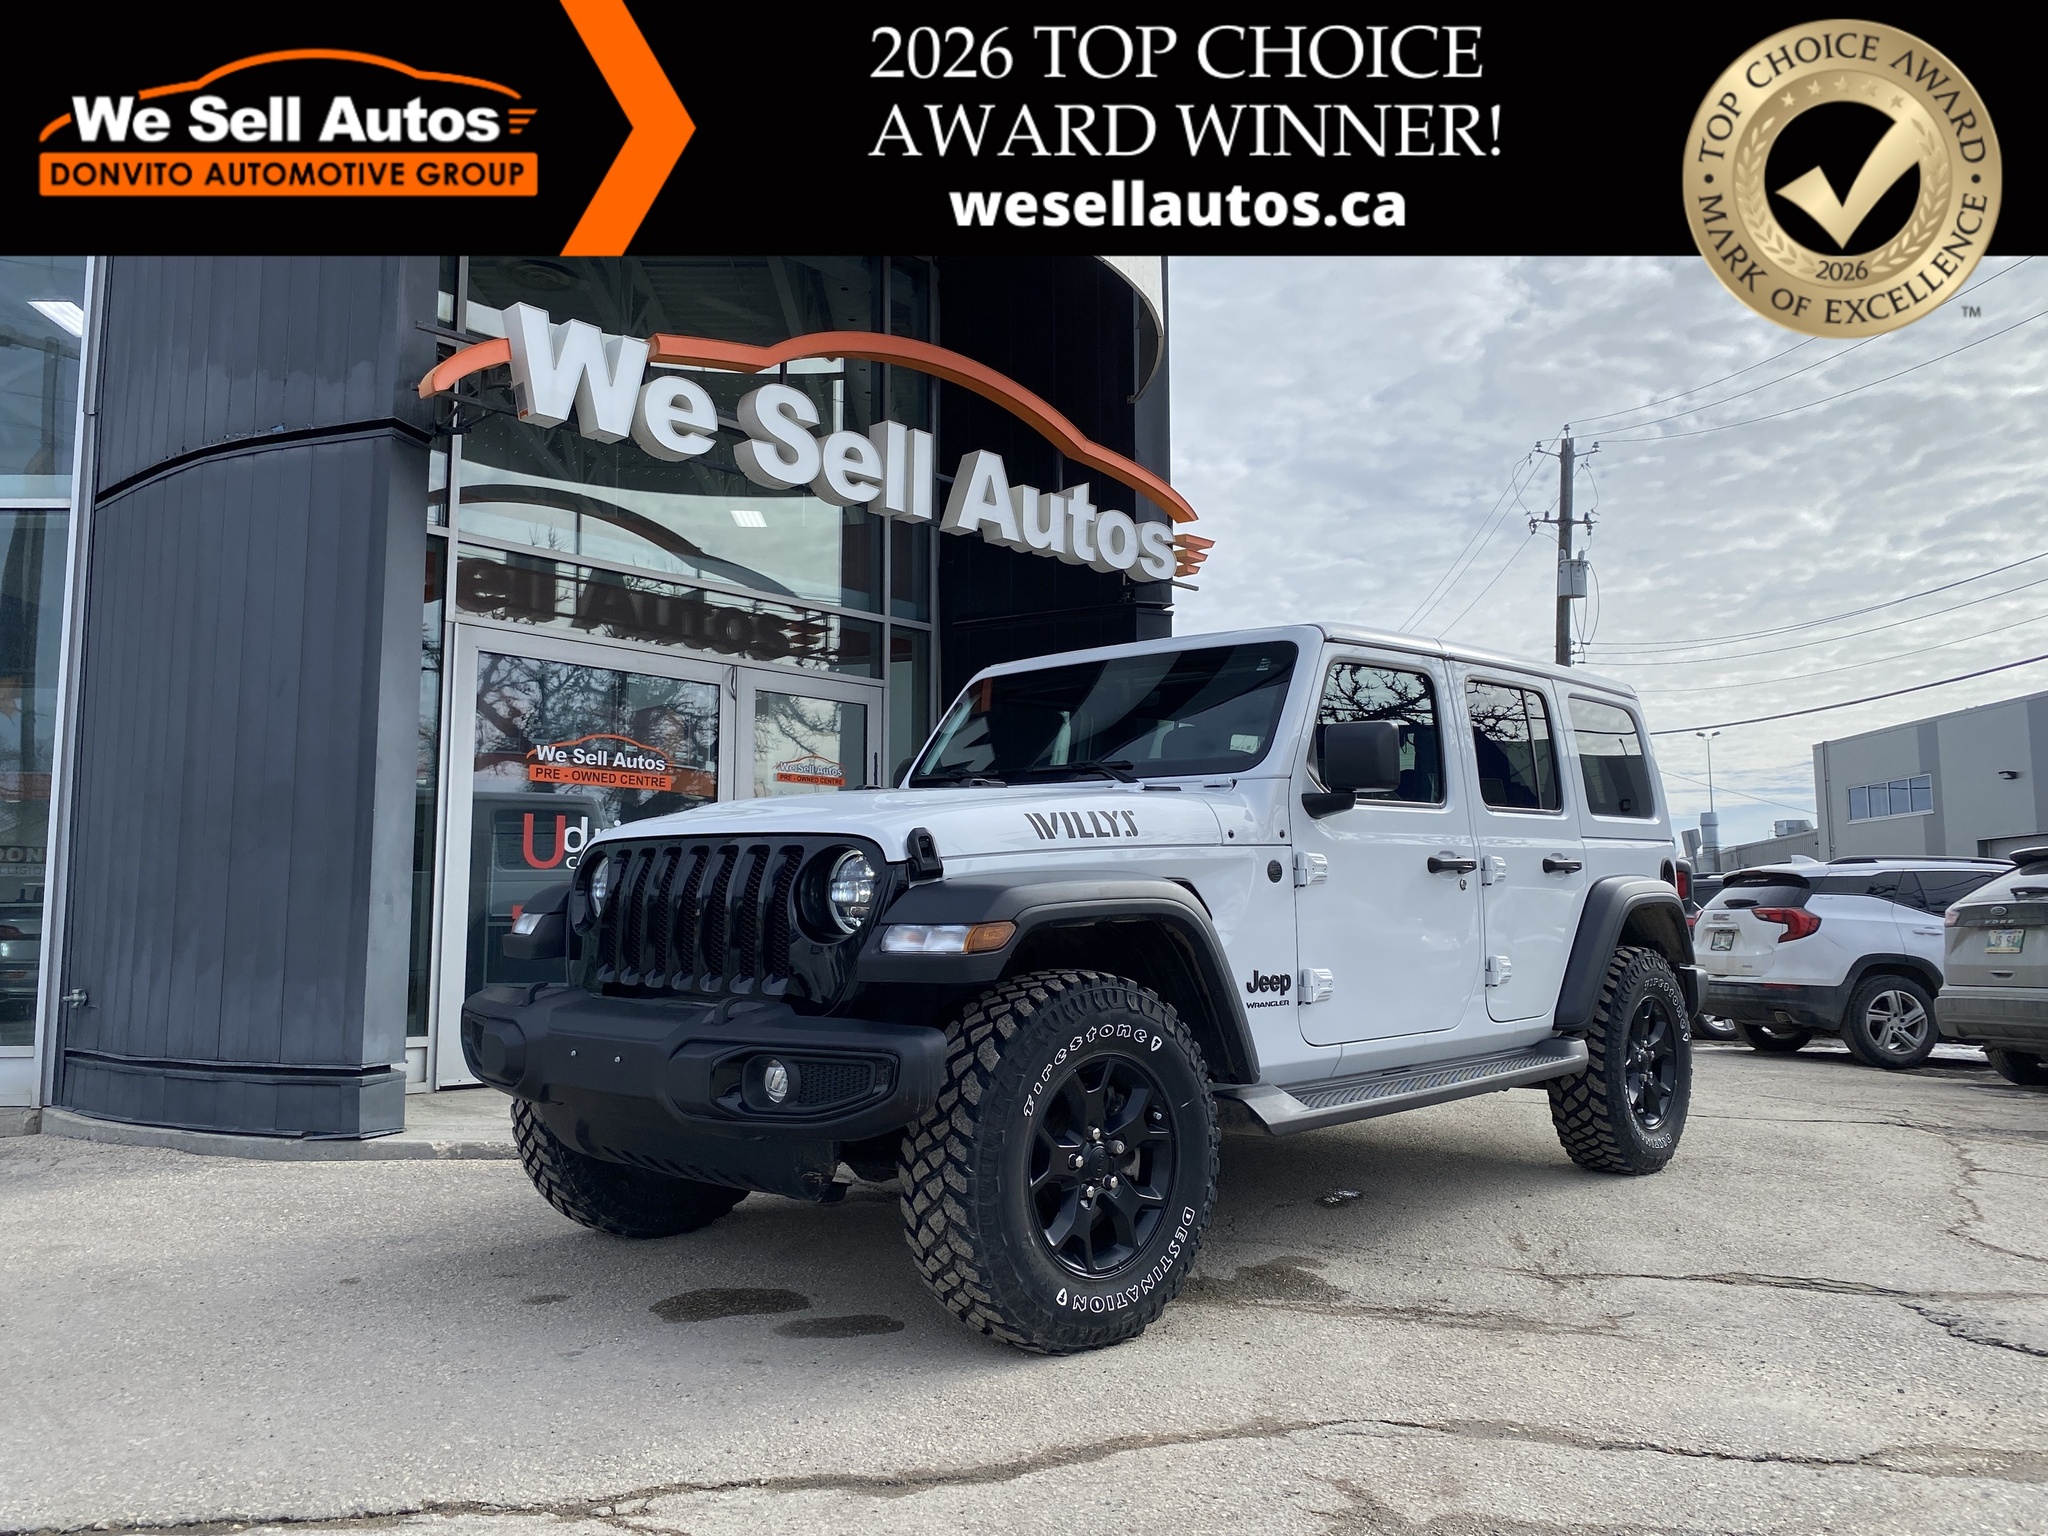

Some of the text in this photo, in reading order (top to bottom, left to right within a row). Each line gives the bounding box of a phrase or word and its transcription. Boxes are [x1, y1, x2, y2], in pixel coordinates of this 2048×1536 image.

[502, 302, 1175, 583] We Sell Autos
[536, 744, 666, 771] We Sell Autos
[780, 762, 843, 777] We Sell Autos
[535, 767, 561, 779] PRE
[571, 770, 617, 784] OWNED
[620, 774, 666, 788] CENTRE
[797, 776, 819, 784] OWNED
[820, 777, 843, 786] CENTRE
[1023, 810, 1139, 840] WILLYS
[1246, 969, 1292, 996] Jeep
[1246, 1000, 1290, 1009] WRANGLER
[1023, 1023, 1148, 1118] Firestone
[1072, 1206, 1196, 1313] DESTINATION
